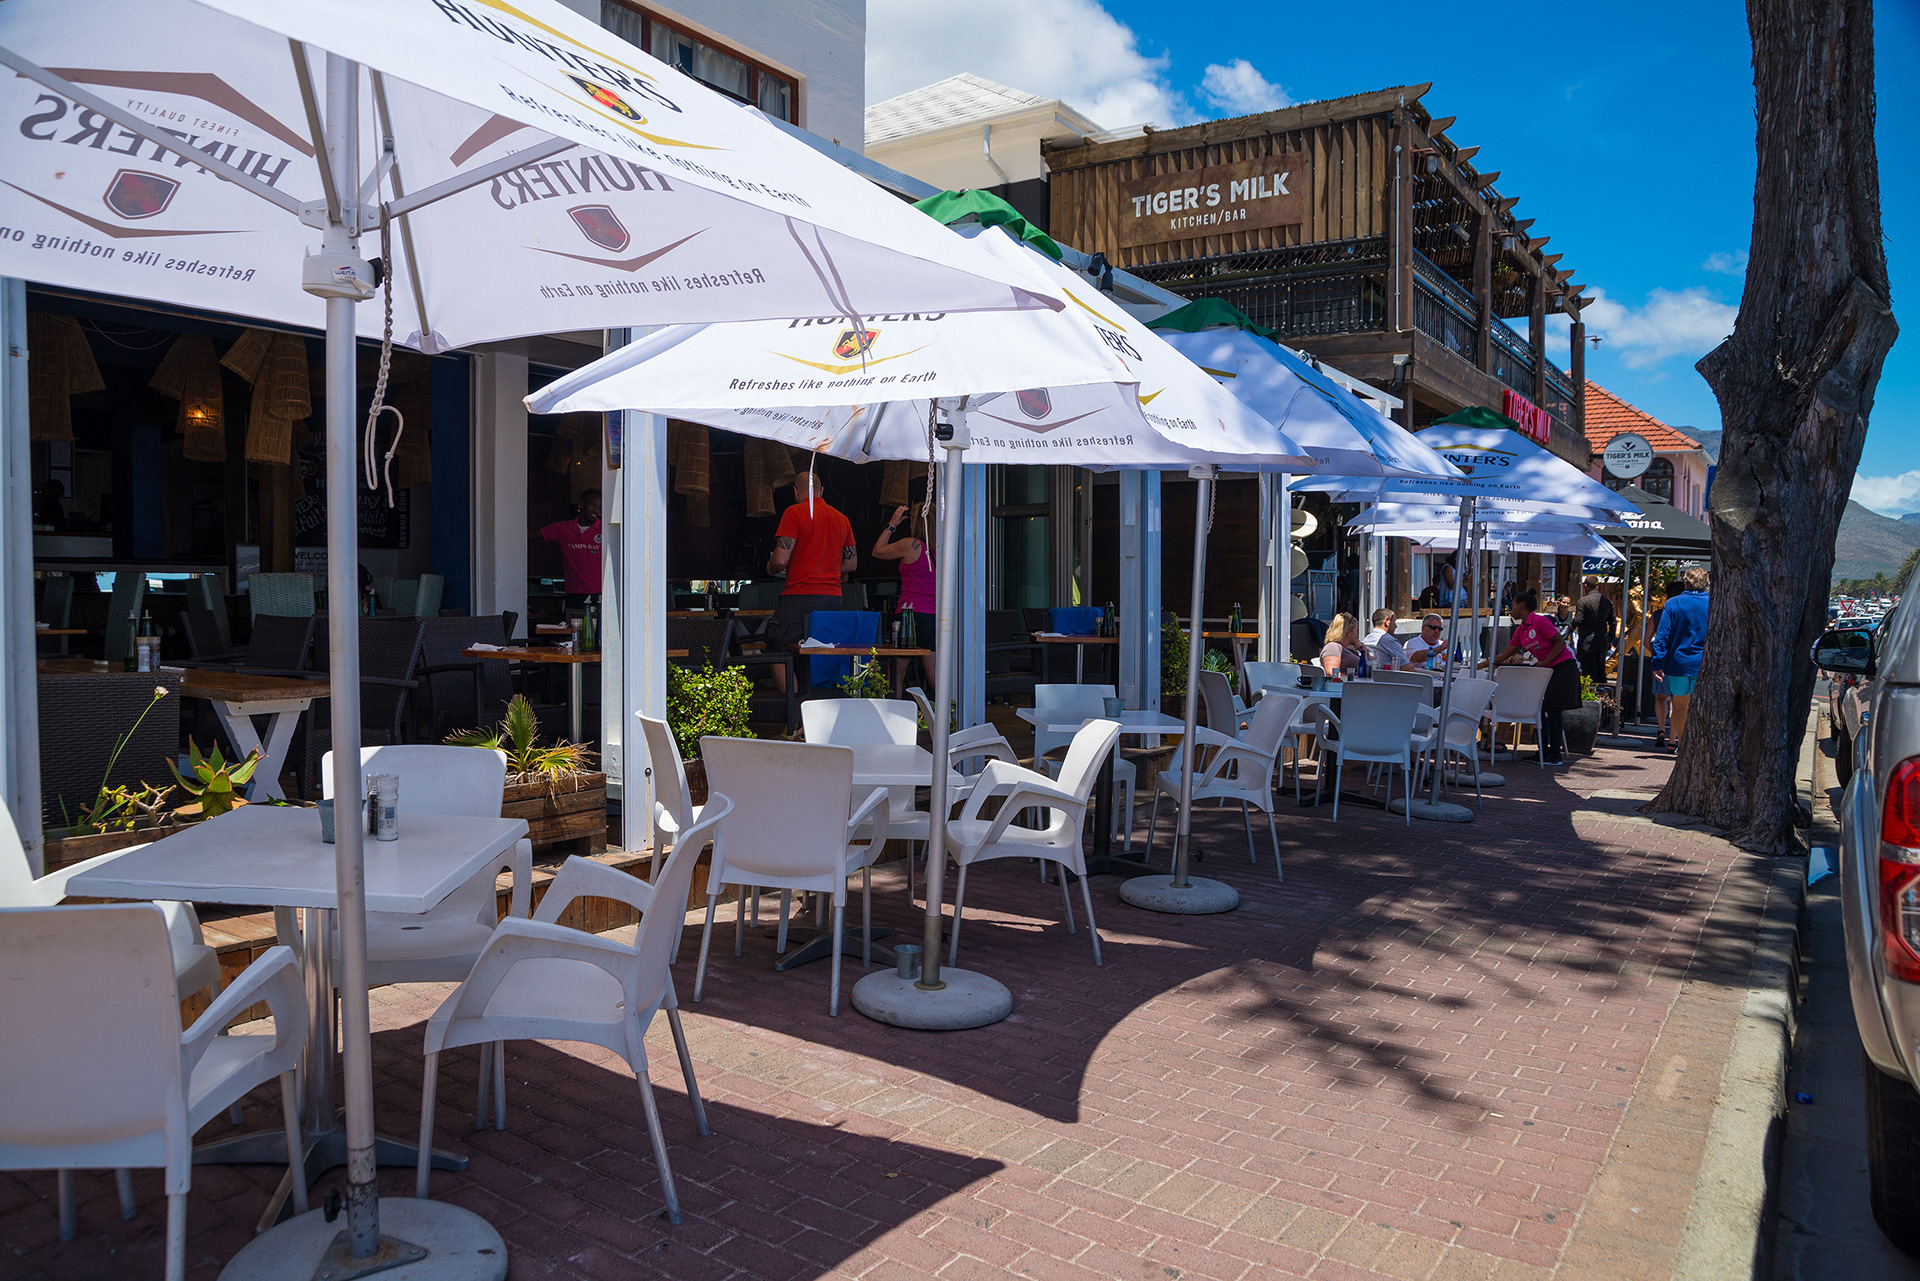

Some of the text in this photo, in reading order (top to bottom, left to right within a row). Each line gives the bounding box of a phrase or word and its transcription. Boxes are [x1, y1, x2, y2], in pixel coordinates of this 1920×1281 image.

[499, 83, 812, 209] Refreshes like nothing on Earth
[1132, 172, 1290, 218] TIGER'S MILK
[1170, 208, 1247, 230] KITCHEN/BAR
[729, 371, 937, 391] Refreshes like nothing on Earth
[1443, 454, 1511, 468] NTER'S
[1606, 451, 1650, 460] TIGER'S MILK
